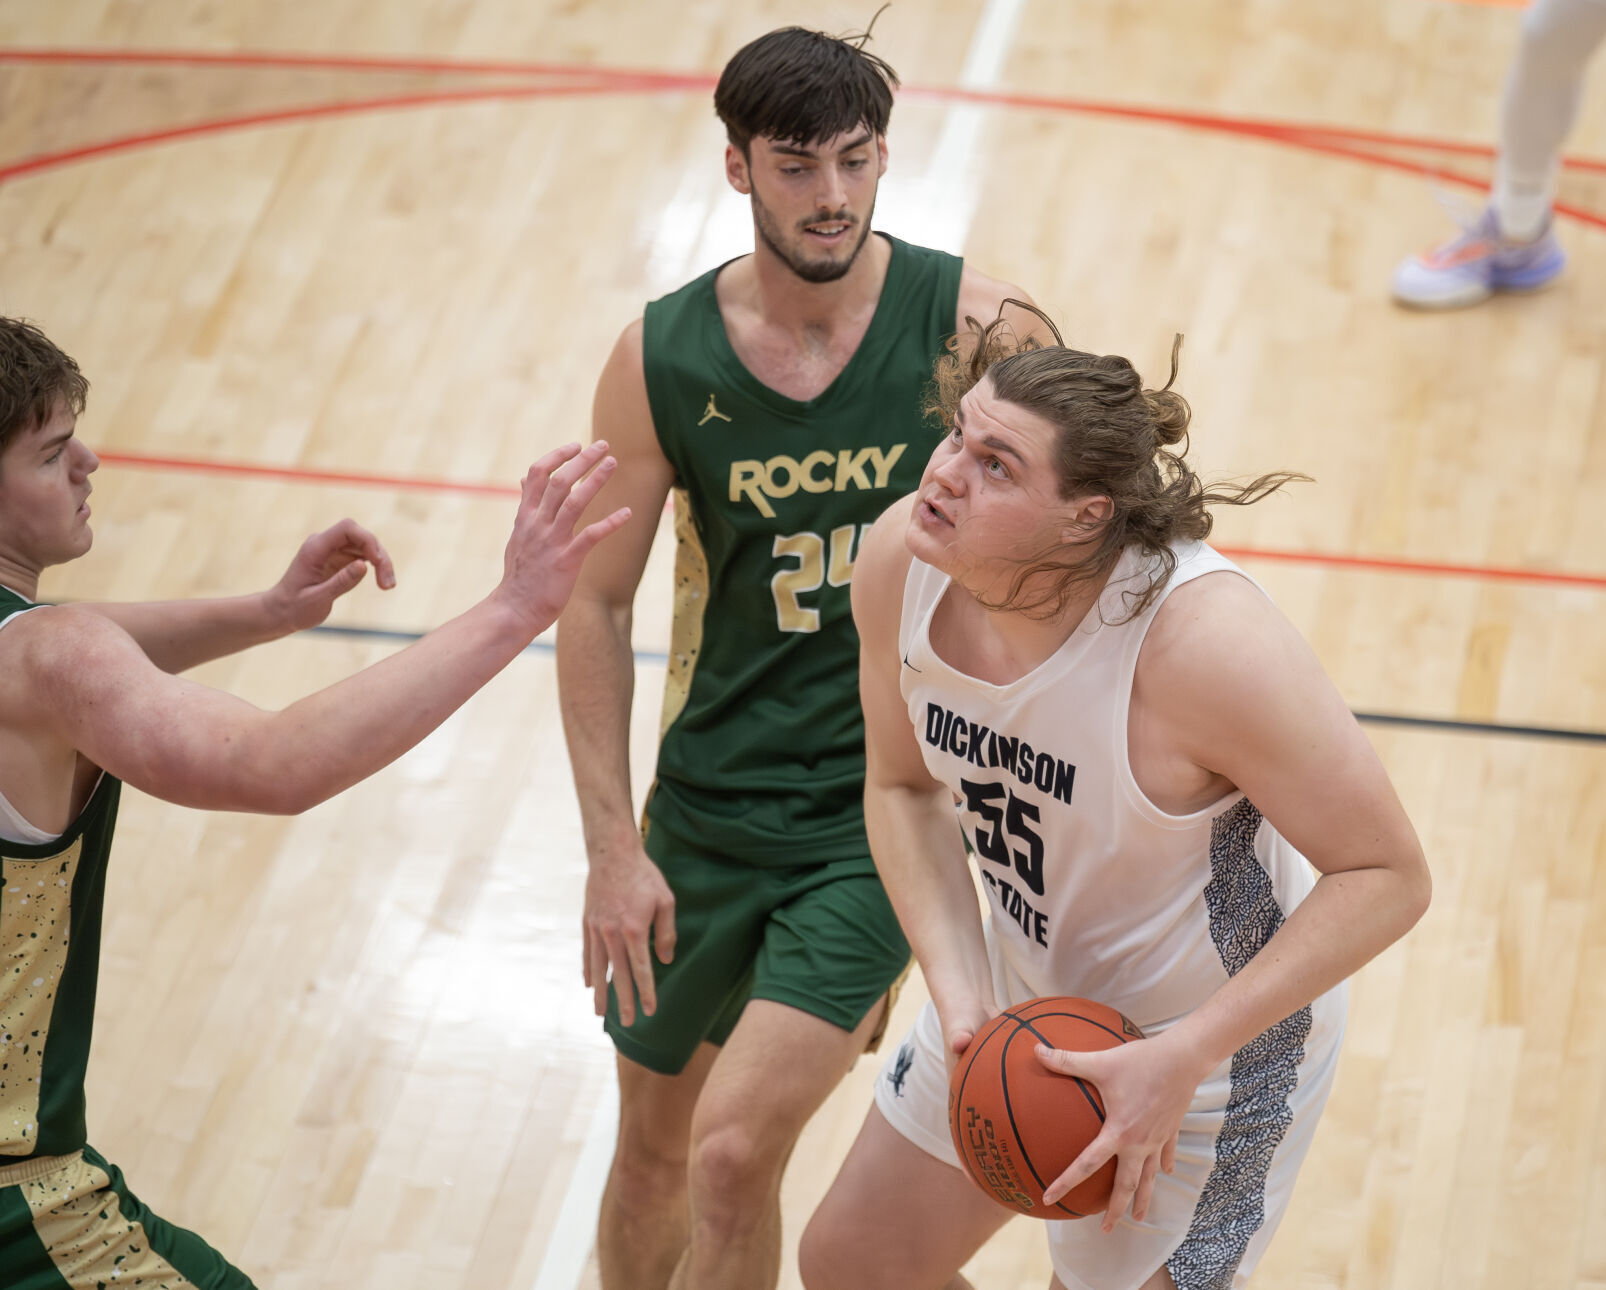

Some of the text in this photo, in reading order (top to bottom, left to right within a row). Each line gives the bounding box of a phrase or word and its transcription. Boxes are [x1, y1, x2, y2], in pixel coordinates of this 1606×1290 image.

[729, 443, 908, 518] ROCKY
[926, 702, 1076, 805] DICKINSON
[960, 778, 1045, 896] 55
